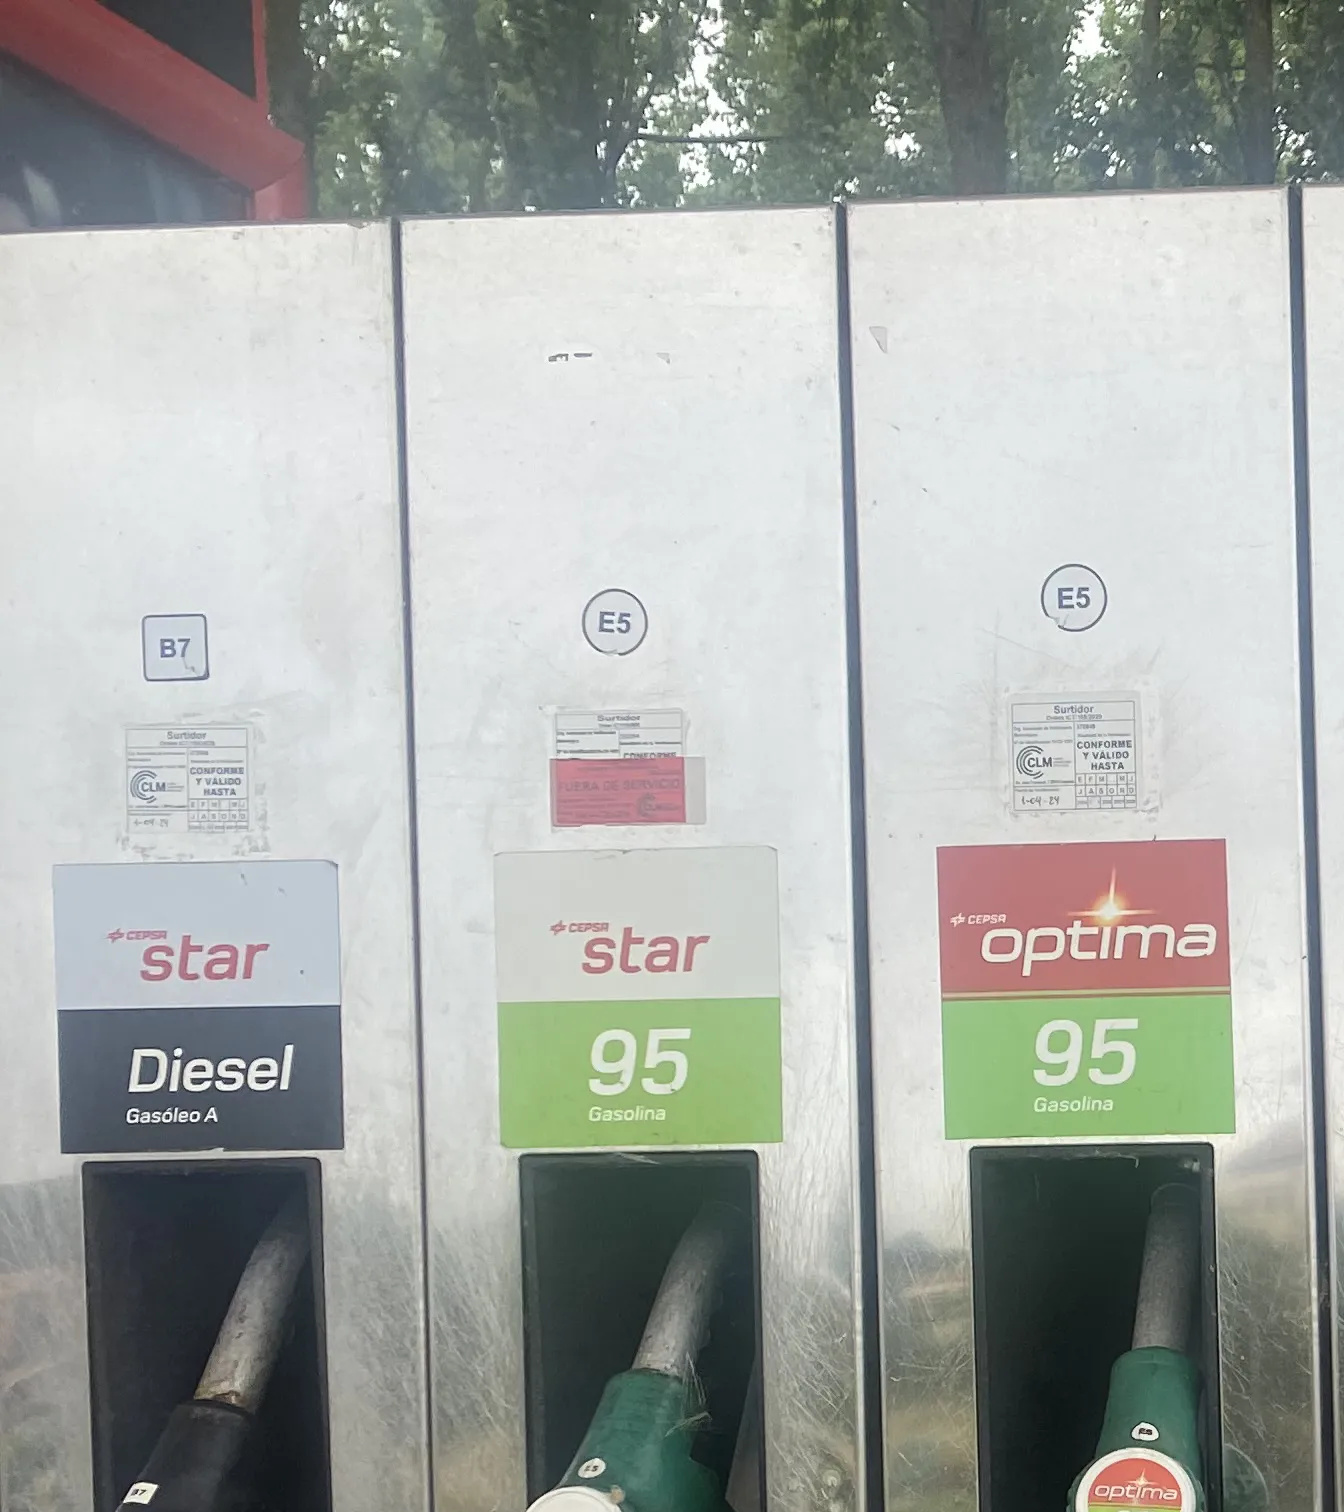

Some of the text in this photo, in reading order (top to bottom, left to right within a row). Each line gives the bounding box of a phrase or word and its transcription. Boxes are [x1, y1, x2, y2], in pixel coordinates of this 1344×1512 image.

[1057, 587, 1091, 609] E5
[598, 611, 631, 634] E5
[160, 638, 191, 658] B7
[1054, 705, 1094, 714] Surtidor
[1077, 740, 1132, 749] CONFORME
[1028, 757, 1053, 767] CLM
[1091, 762, 1124, 771] HASTA
[190, 767, 244, 775] CONFORME
[141, 782, 166, 792] CLM
[203, 788, 236, 796] HASTA
[967, 913, 1007, 925] CEPSA
[126, 930, 168, 940] CEPSA
[568, 922, 609, 933] CEPSA
[581, 926, 711, 974] star
[981, 919, 1217, 977] optima
[140, 934, 270, 981] star
[1033, 1018, 1139, 1086] 95
[128, 1044, 294, 1093] Diesel
[588, 1028, 692, 1096] 95
[1033, 1096, 1114, 1112] Gasolina
[126, 1107, 218, 1123] Gasóleo A
[588, 1105, 666, 1122] Gasolina
[1094, 1484, 1178, 1501] optima
